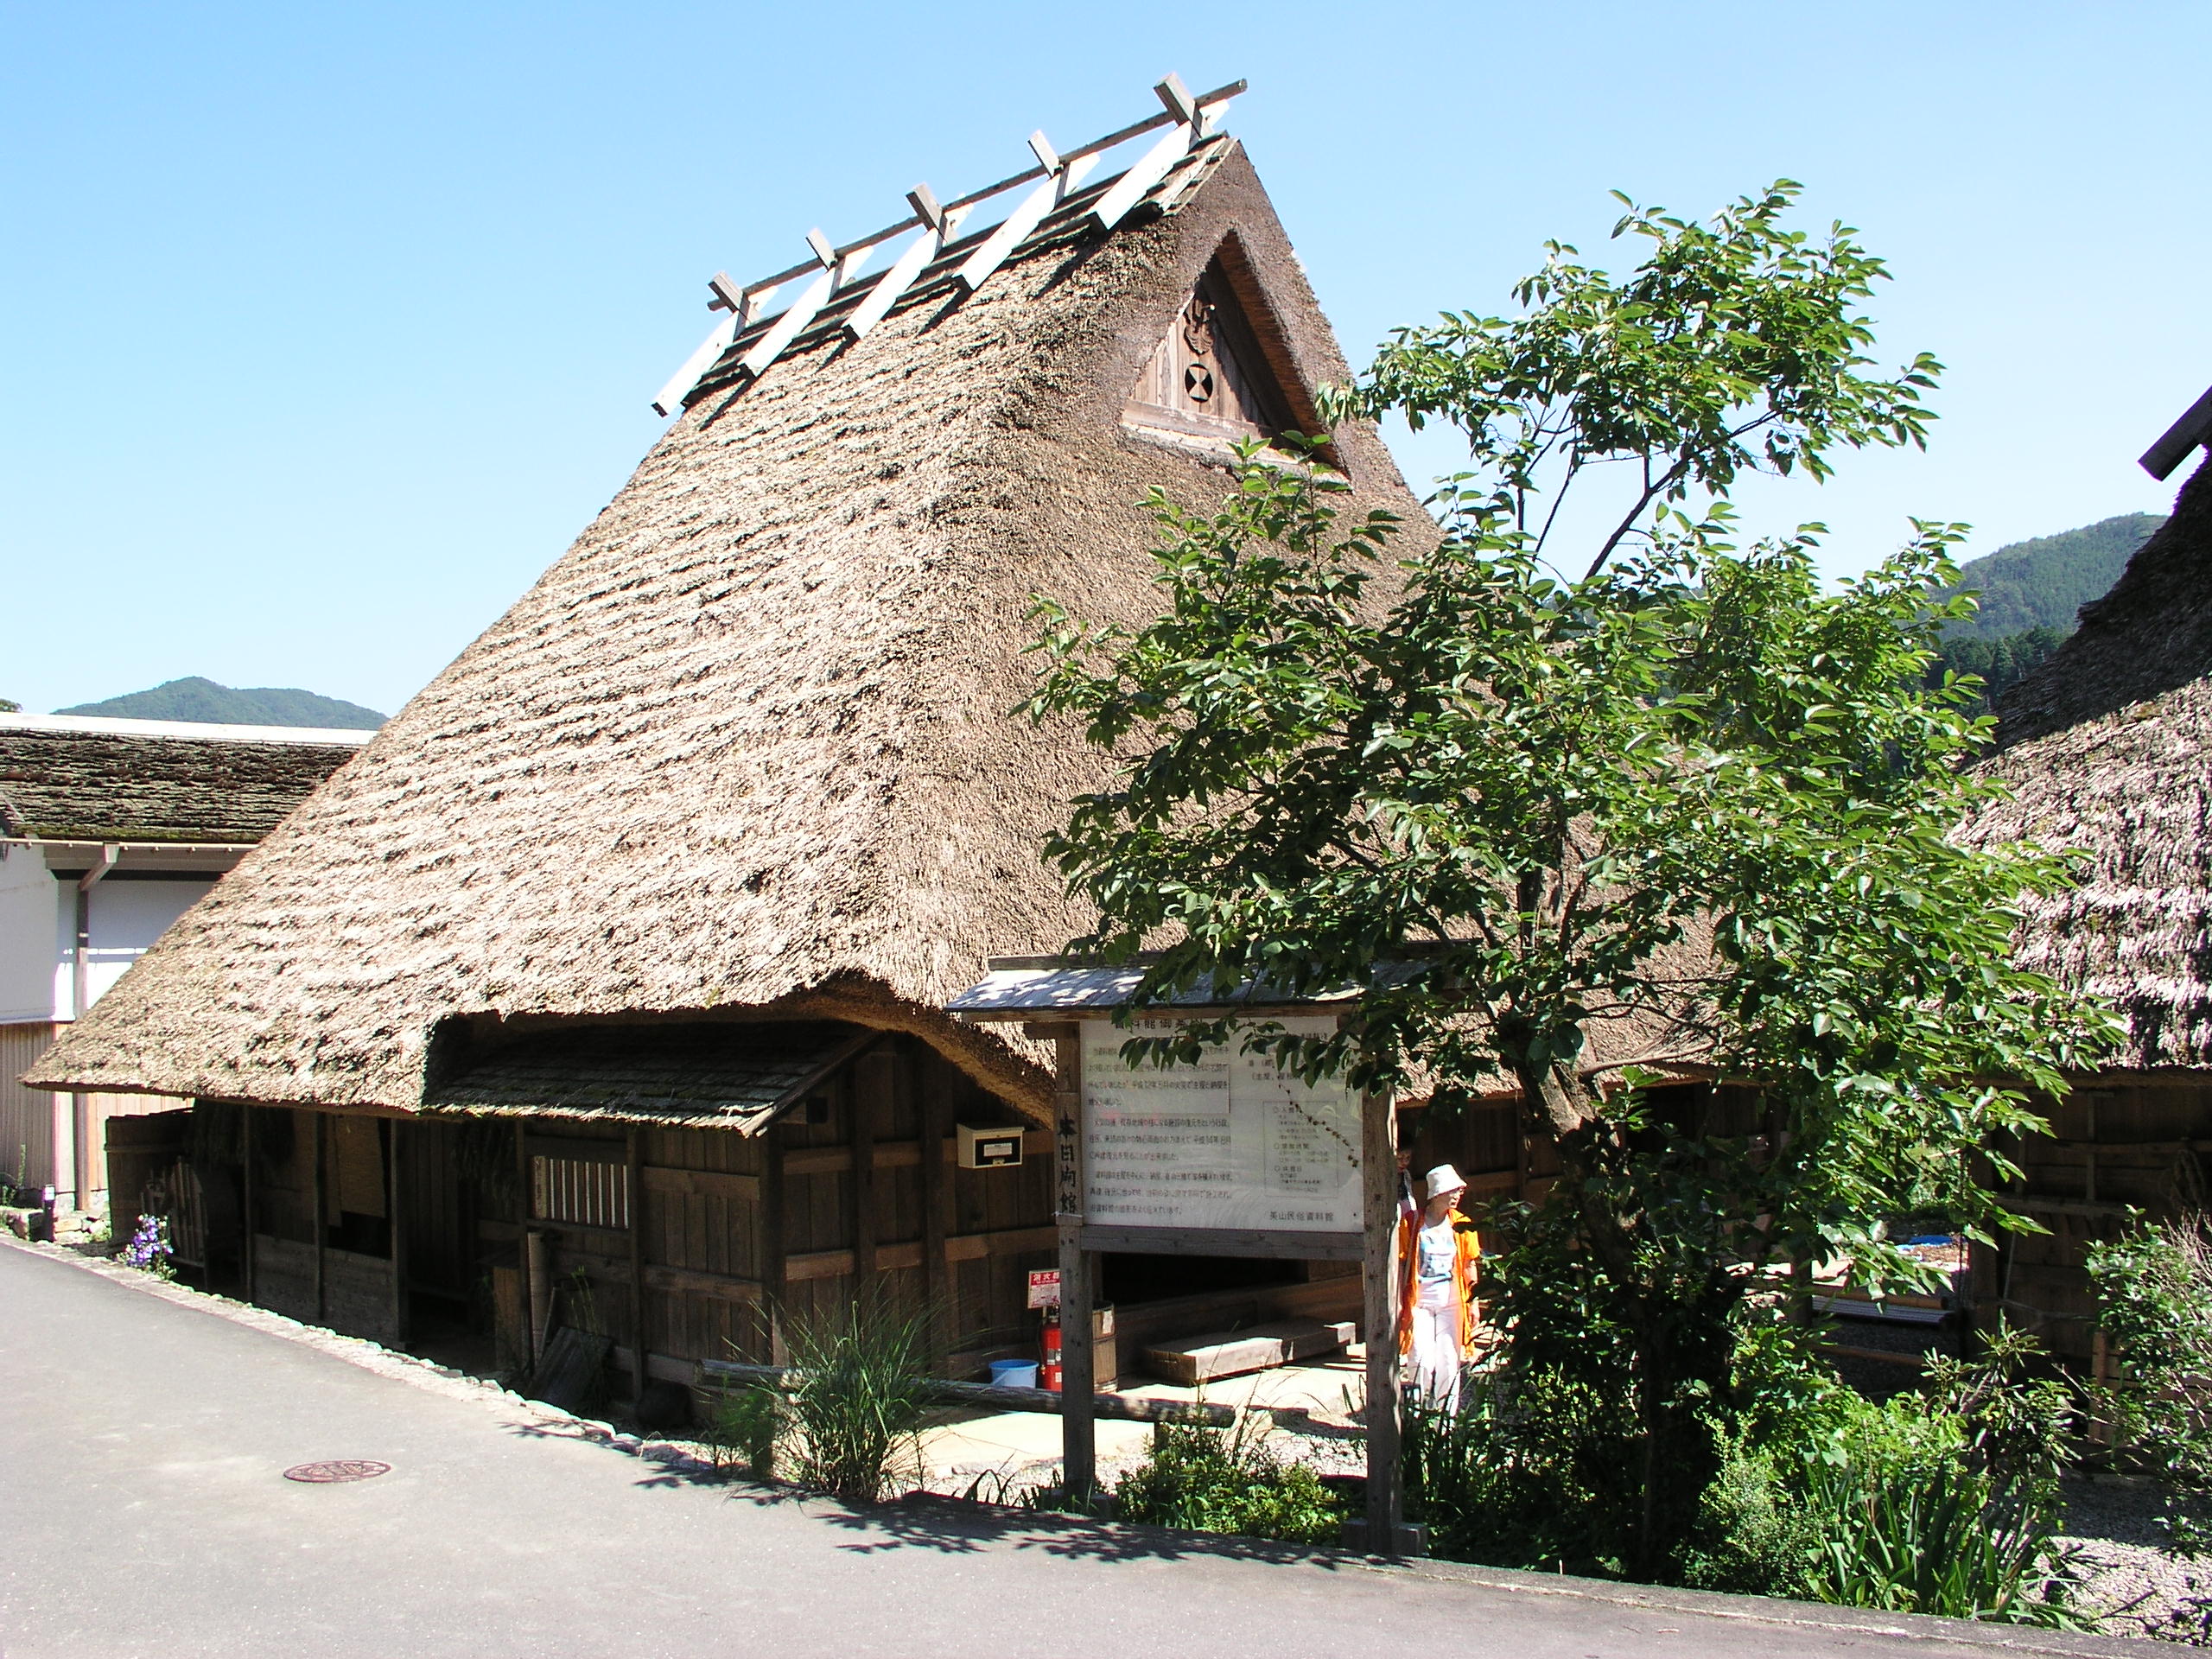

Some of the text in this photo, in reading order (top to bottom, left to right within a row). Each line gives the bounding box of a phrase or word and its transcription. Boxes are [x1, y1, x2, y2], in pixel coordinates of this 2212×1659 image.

[1058, 1110, 1077, 1213] 本日開館
[1269, 1211, 1334, 1222] 美山民俗資料館
